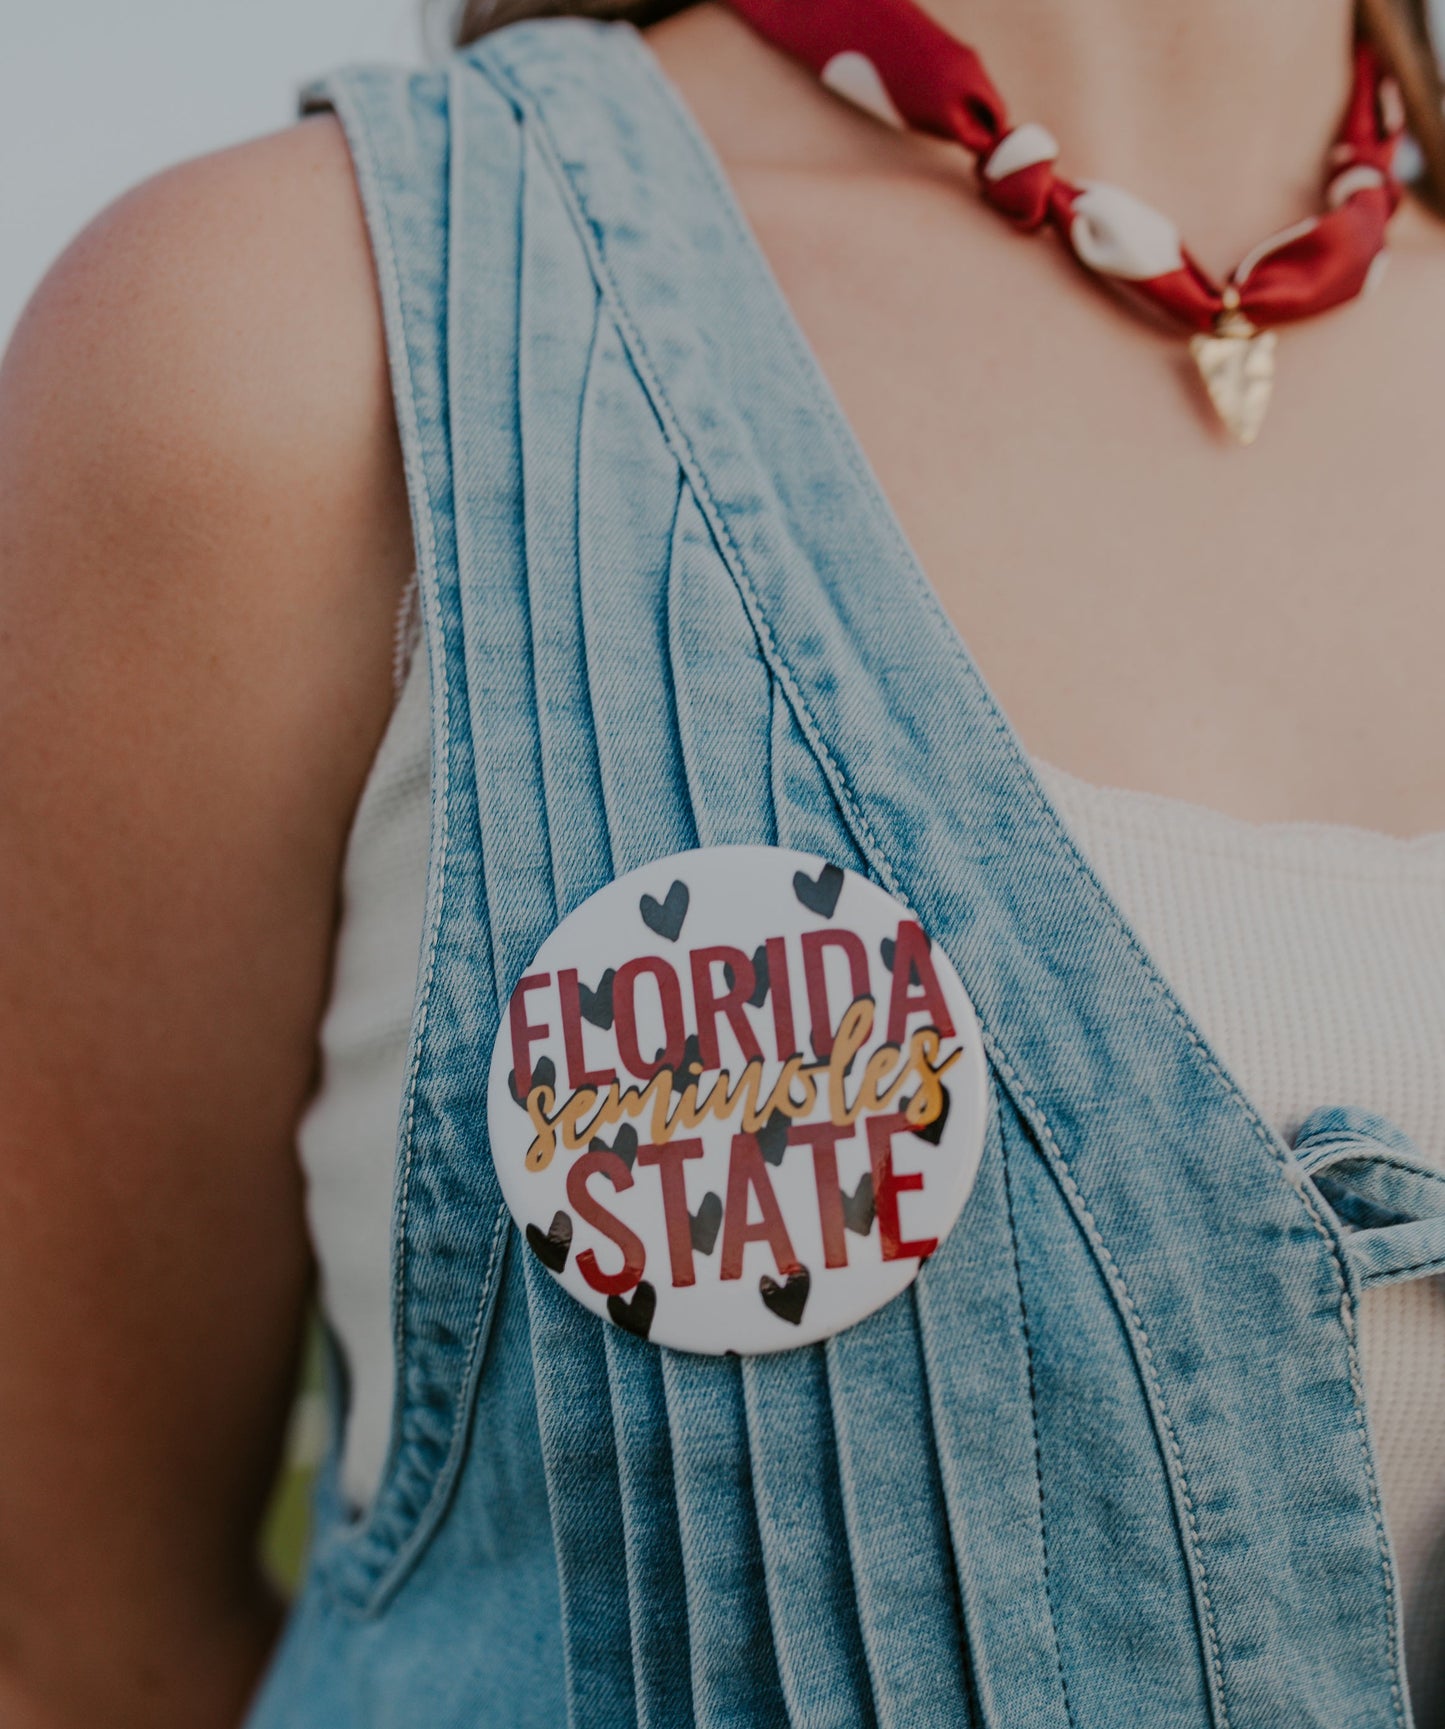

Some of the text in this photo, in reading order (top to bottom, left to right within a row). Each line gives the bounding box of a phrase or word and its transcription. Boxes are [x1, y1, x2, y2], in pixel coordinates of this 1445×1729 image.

[509, 920, 956, 1098] FLORIDA
[525, 994, 963, 1172] seminoles
[566, 1112, 938, 1295] STATE
